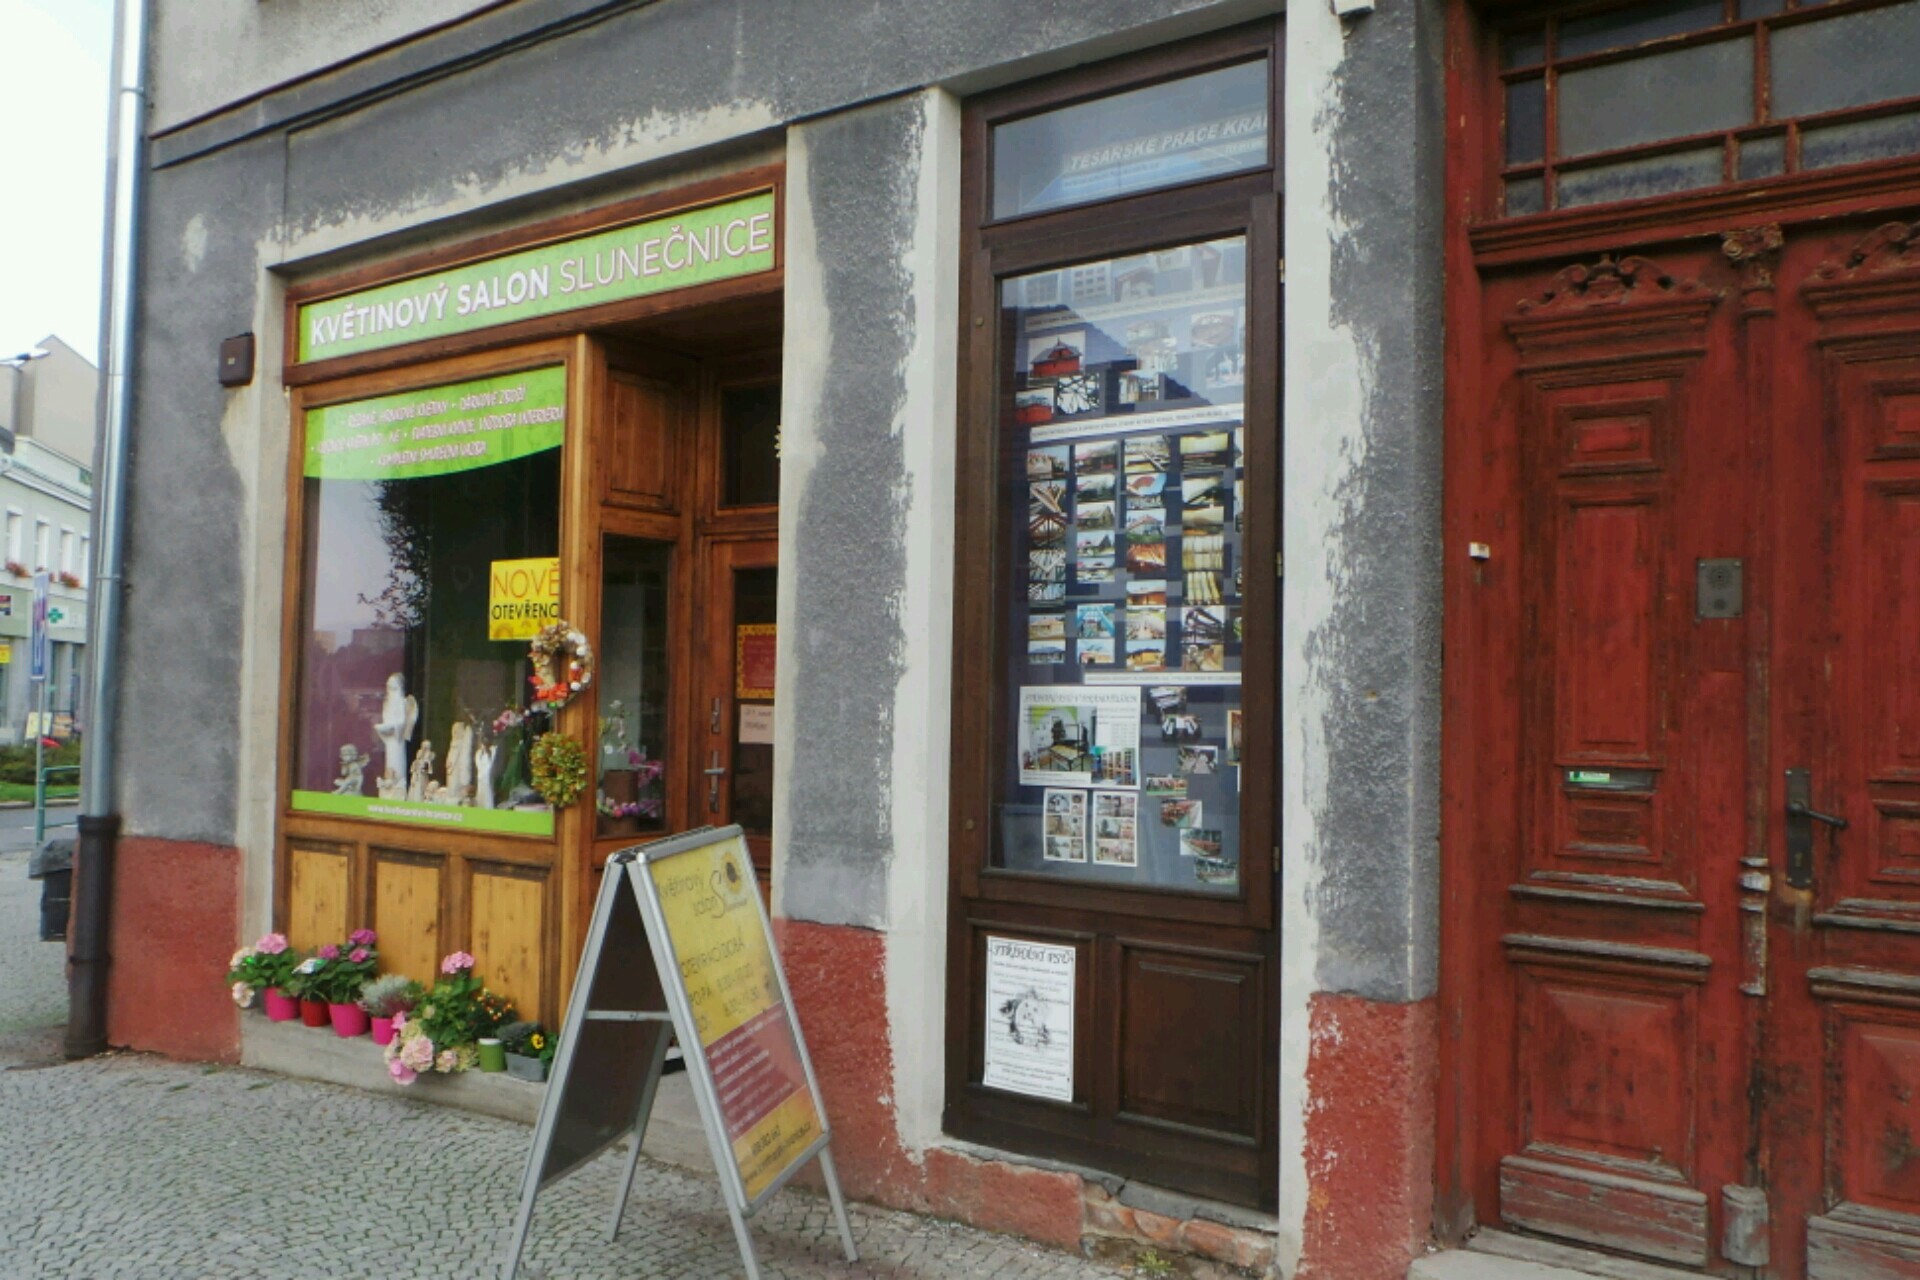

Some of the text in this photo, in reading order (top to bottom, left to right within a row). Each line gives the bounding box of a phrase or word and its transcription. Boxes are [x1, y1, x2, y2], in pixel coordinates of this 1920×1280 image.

[311, 211, 771, 346] KVĚTINOVÝ SALON SLUNEČNICE
